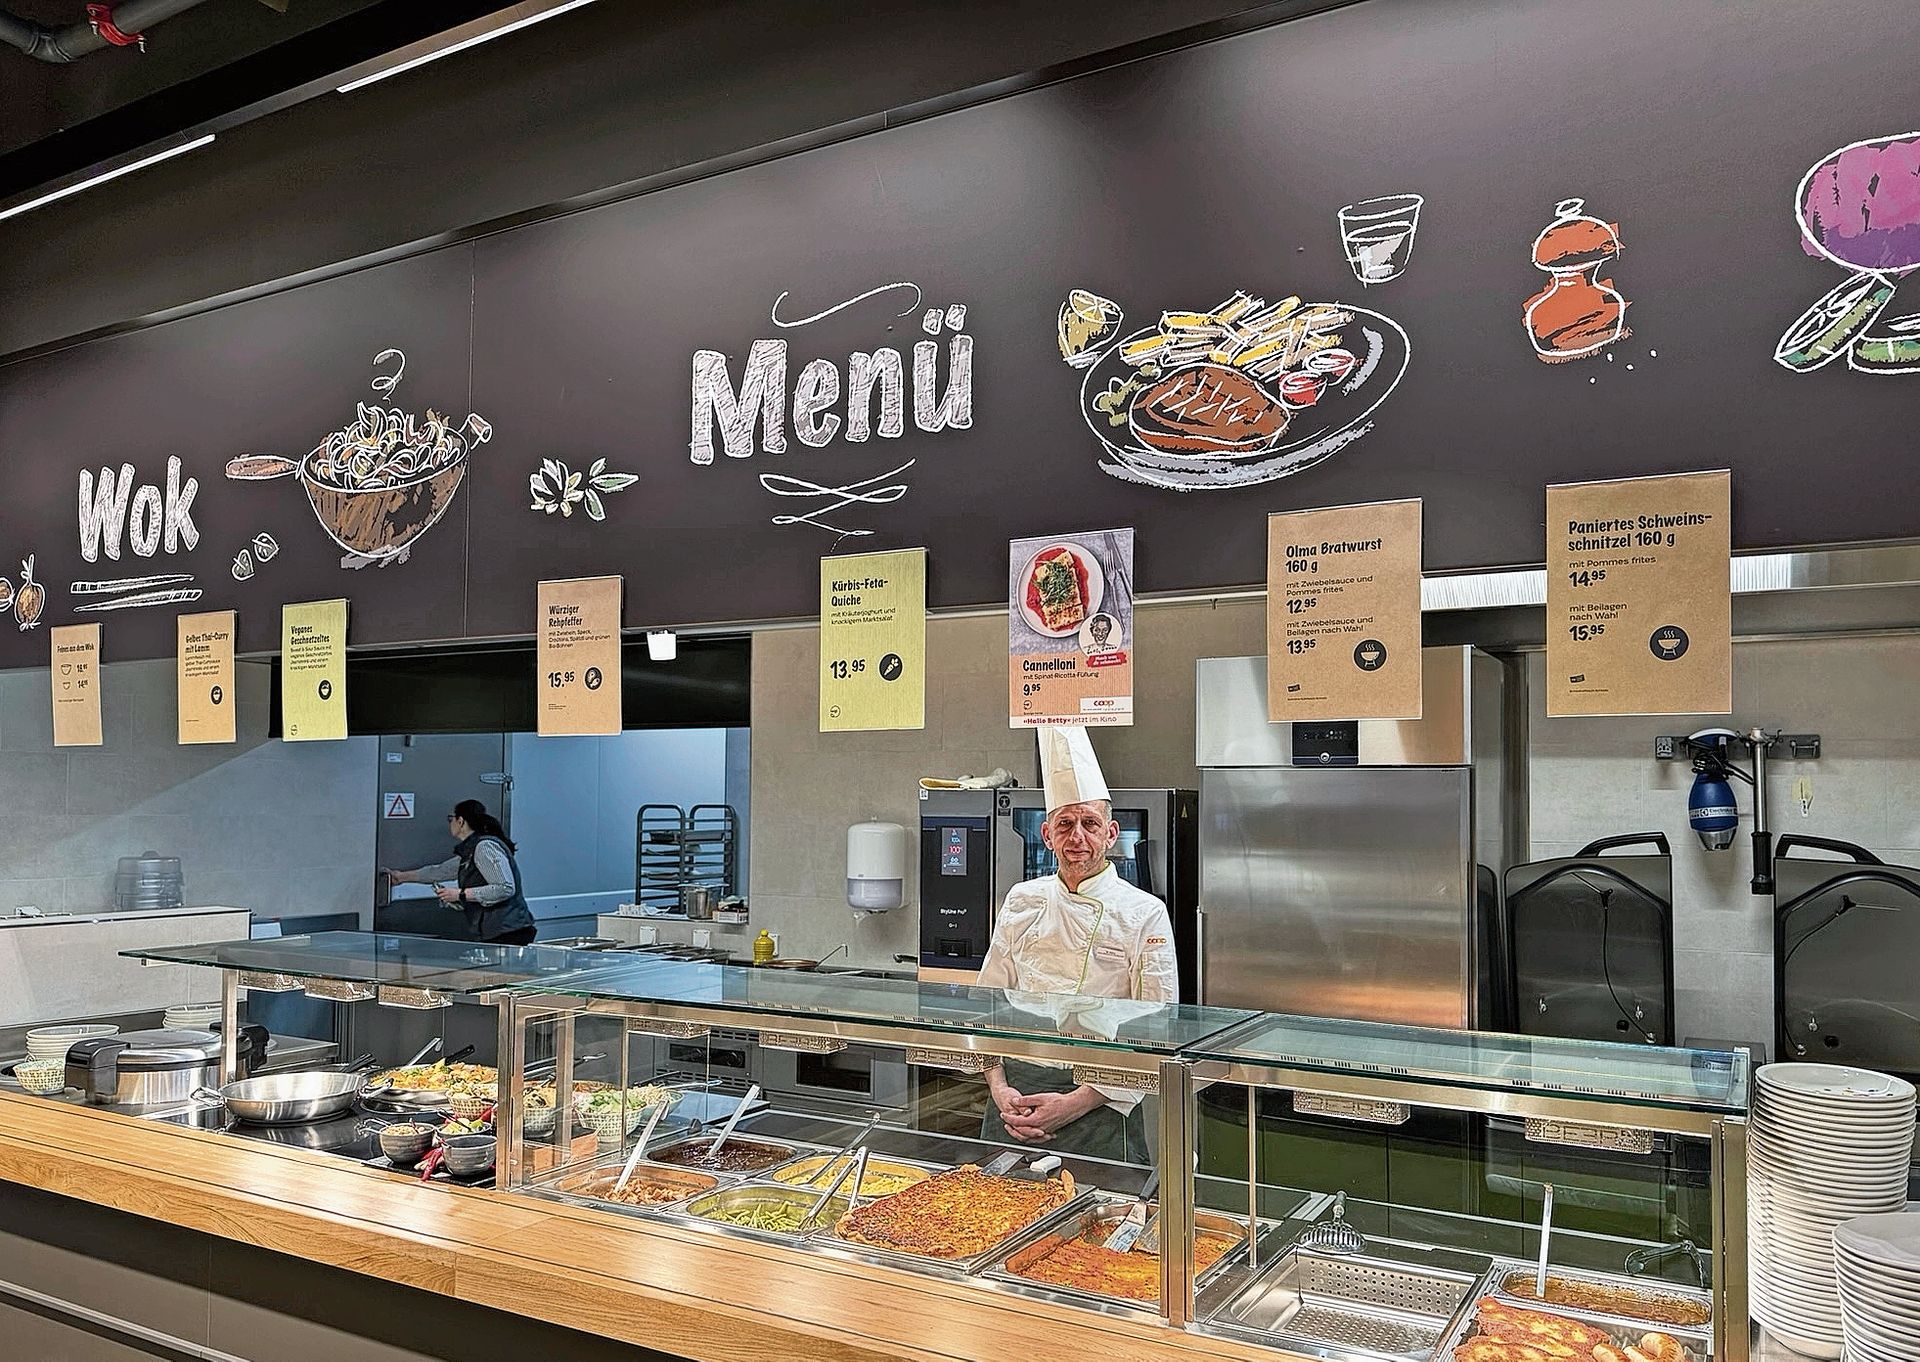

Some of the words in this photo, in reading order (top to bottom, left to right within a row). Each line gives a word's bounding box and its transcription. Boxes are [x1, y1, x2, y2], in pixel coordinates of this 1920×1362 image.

[690, 303, 973, 466] Menü
[78, 454, 200, 563] Wok
[1568, 518, 1635, 534] Paniertes
[1637, 512, 1713, 529] Schweins-
[1286, 545, 1317, 558] Olma
[1321, 538, 1382, 555] Bratwurst
[1568, 533, 1631, 551] schnitzel
[1634, 531, 1661, 546] 160
[1666, 532, 1675, 547] g
[1285, 559, 1308, 573] 160
[1311, 561, 1318, 573] g
[1587, 558, 1629, 567] Pommes
[1631, 556, 1656, 564] frites
[831, 577, 888, 593] Kürbis-Feta-
[1301, 578, 1354, 588] Zwiebelsauce
[1568, 570, 1606, 587] 14.95
[1286, 589, 1321, 597] Pommes
[1323, 586, 1343, 594] frites
[831, 594, 861, 607] Quiche
[1286, 597, 1316, 614] 12.95
[1569, 604, 1585, 612] mit
[1587, 603, 1627, 612] Beilagen
[548, 604, 580, 616] Würziger
[1569, 613, 1593, 621] nach
[1594, 611, 1619, 620] Wahl
[548, 616, 583, 628] Rehpfeffer
[1287, 621, 1299, 629] mit
[1301, 618, 1355, 628] Zwiebelsauce
[1357, 616, 1373, 624] und
[290, 625, 313, 636] Veganes
[1287, 628, 1320, 637] Beilagen
[1343, 625, 1363, 633] Wahl
[1569, 624, 1605, 641] 15.95
[290, 634, 330, 645] Geschnetzeltes
[1287, 639, 1316, 655] 13.95
[830, 659, 865, 679] 13.95
[1023, 657, 1076, 672] Cannelloni
[548, 671, 575, 688] 15.95
[1023, 683, 1041, 696] 9.95
